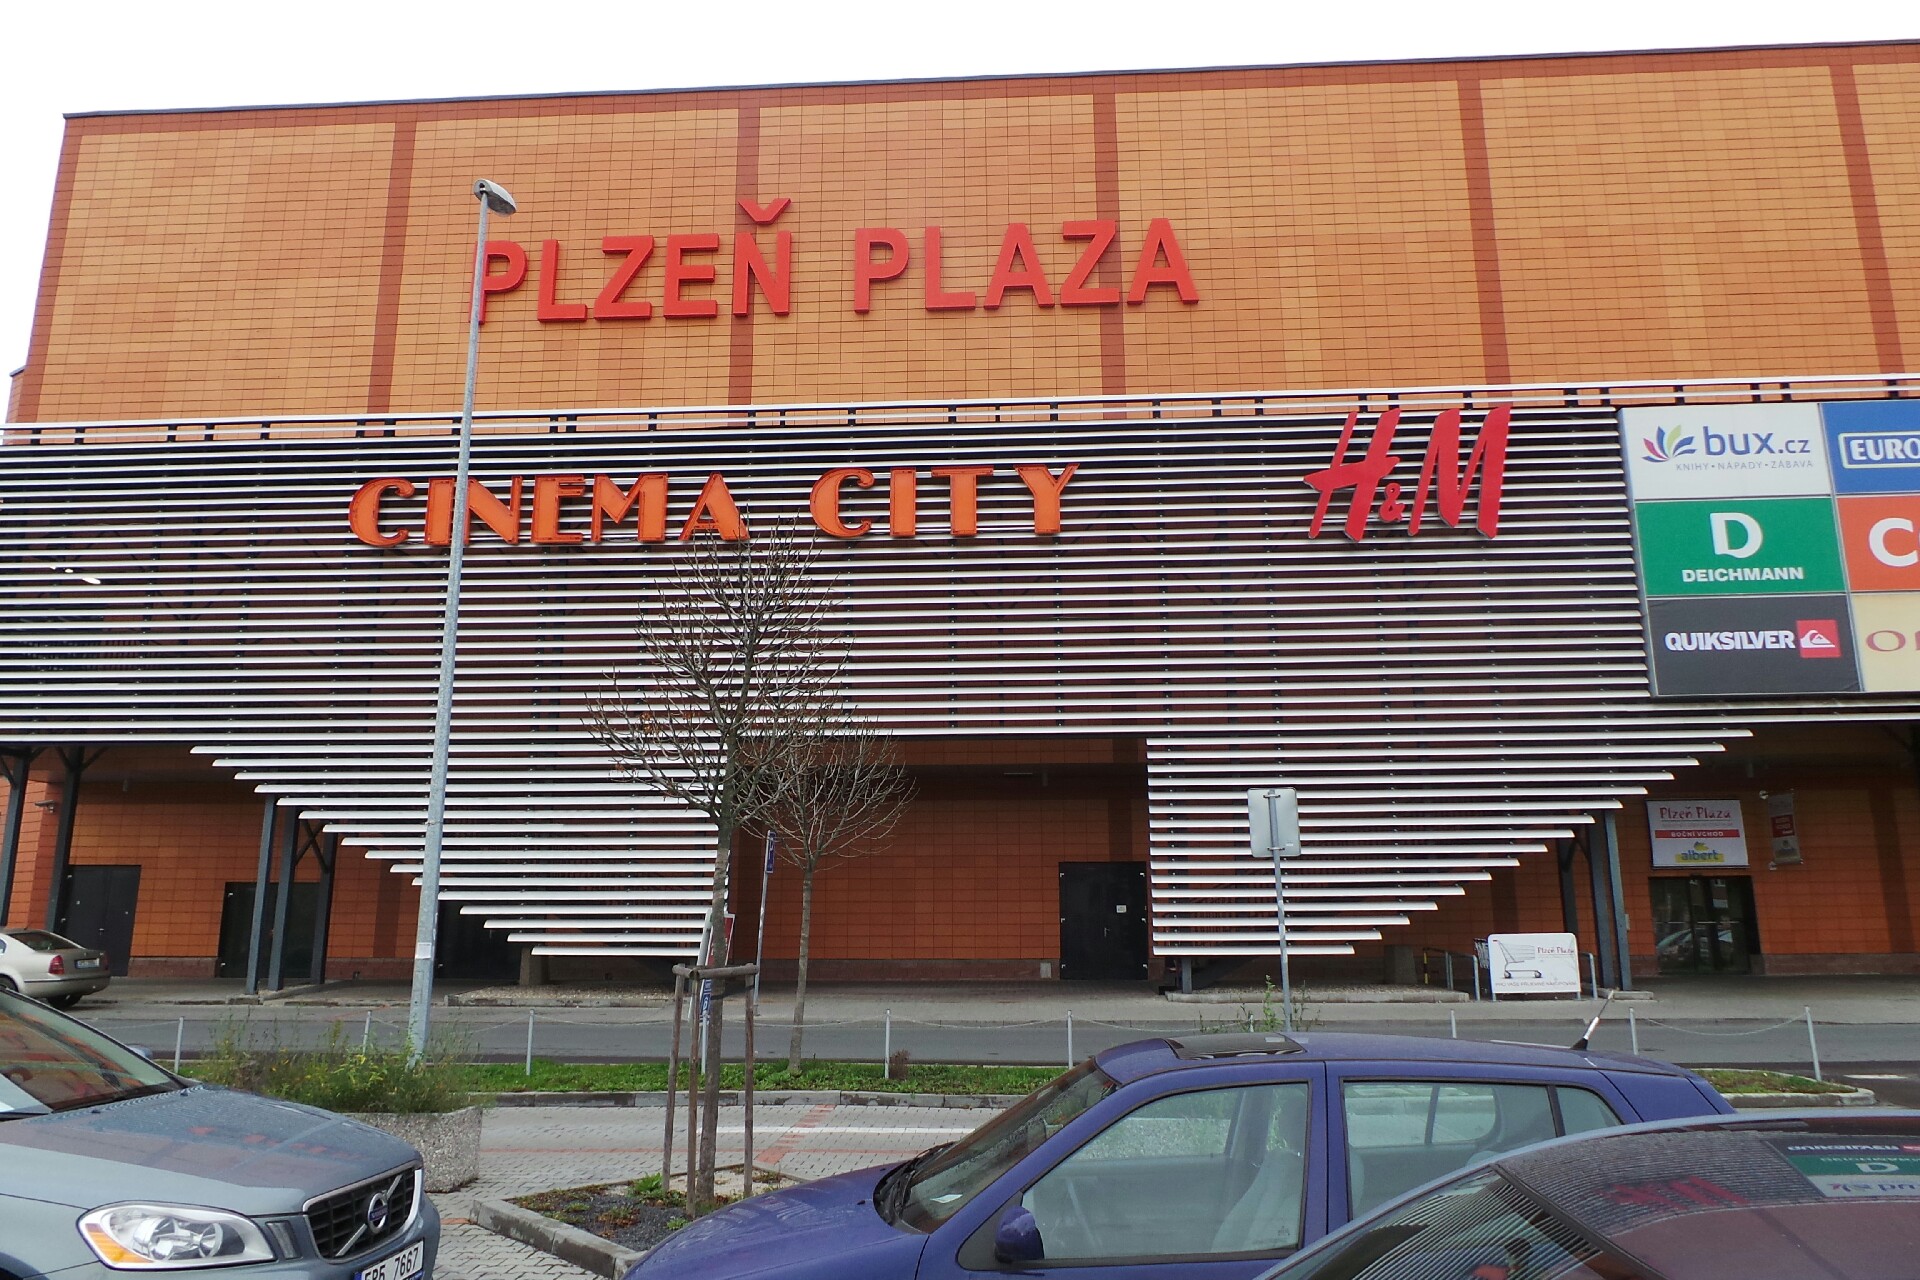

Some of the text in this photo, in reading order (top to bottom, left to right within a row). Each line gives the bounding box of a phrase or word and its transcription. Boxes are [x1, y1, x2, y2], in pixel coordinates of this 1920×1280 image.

[469, 198, 1199, 324] PLZEŇ PLAZA
[1703, 426, 1811, 455] bux.cz
[1850, 438, 1920, 460] EURO
[1303, 404, 1511, 542] H&M
[1676, 463, 1709, 471] KNIHY
[1771, 459, 1813, 469] ZÁBAVA
[348, 463, 1080, 547] CINEMA CITY
[1710, 512, 1763, 559] D
[1869, 517, 1920, 567] C
[1682, 567, 1804, 582] DEICHMANN
[1664, 630, 1796, 651] QUIKSILVER
[1866, 629, 1920, 652] O
[1660, 806, 1731, 819] Plzeň Plaza
[1681, 849, 1719, 861] albert
[394, 1247, 419, 1280] 7667
